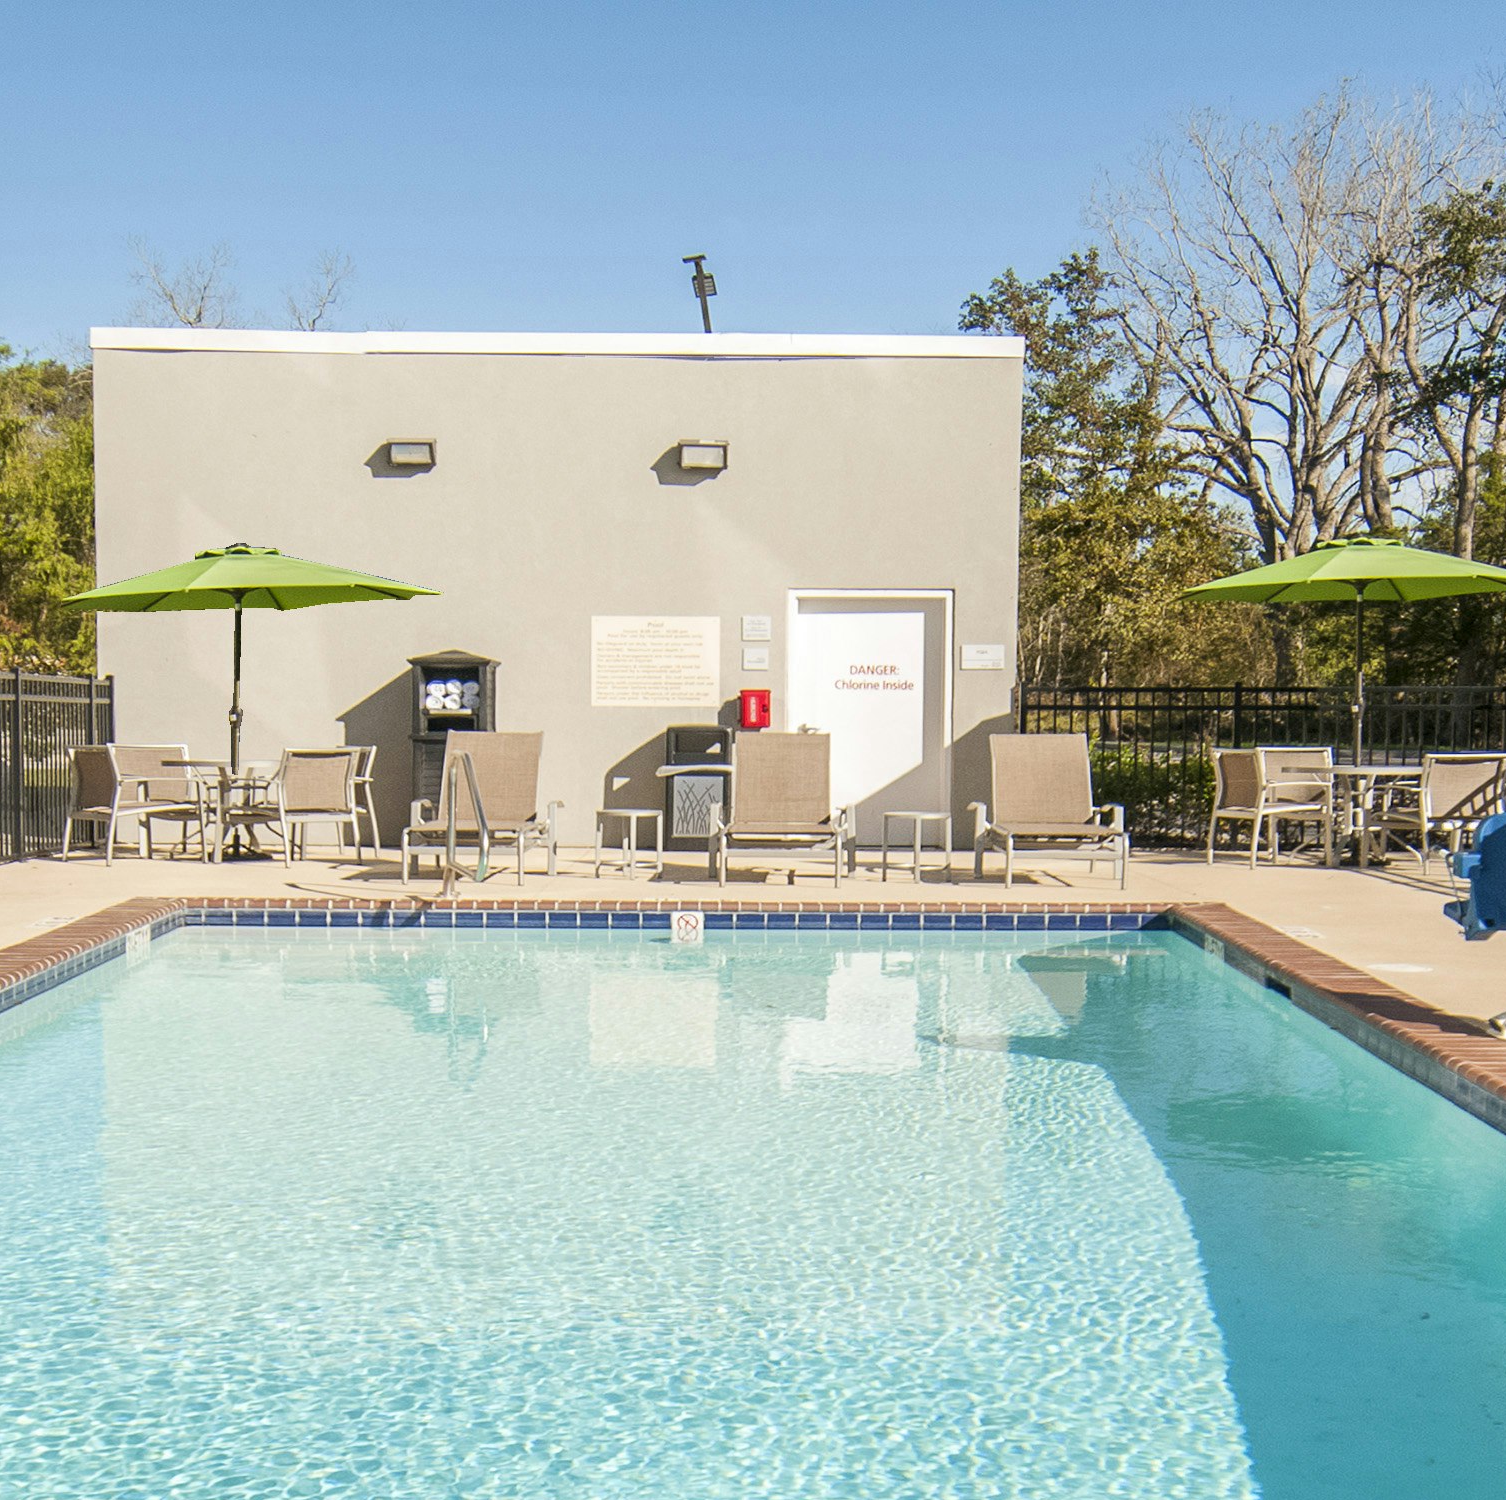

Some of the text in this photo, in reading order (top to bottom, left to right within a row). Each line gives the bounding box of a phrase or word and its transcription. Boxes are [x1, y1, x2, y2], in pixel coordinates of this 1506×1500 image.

[849, 664, 900, 676] DANGER:
[834, 679, 914, 690] Chlorine Inside
